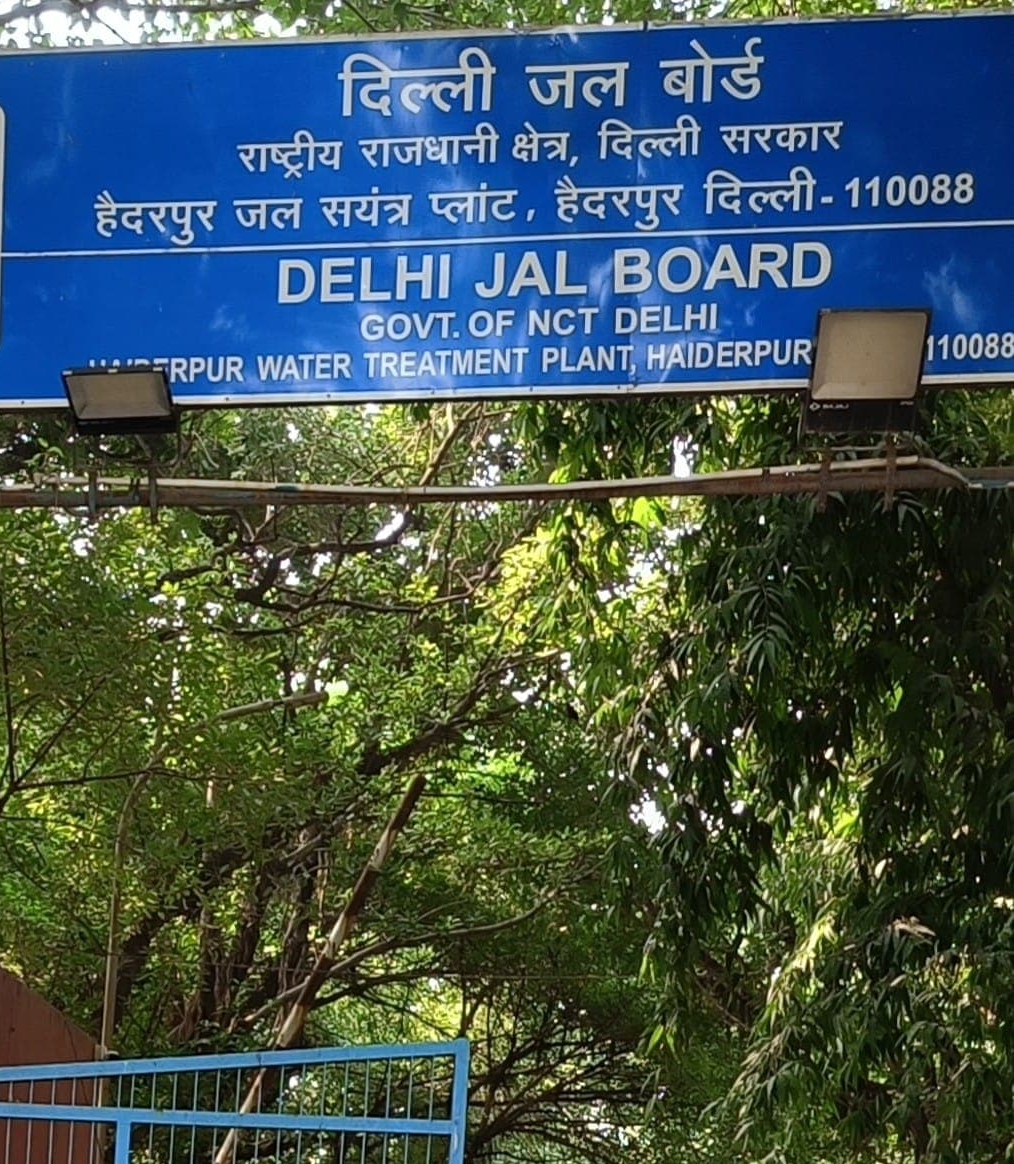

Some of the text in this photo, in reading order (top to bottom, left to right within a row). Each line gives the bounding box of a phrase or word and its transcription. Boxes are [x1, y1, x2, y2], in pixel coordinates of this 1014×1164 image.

[338, 37, 764, 116] दिल्ली जल बोर्ड
[238, 115, 843, 178] राष्ट्रीय राजधानी क्षेत्र, दिल्ली सरकार
[94, 191, 216, 245] हैदरपुर
[234, 198, 302, 230] जल
[555, 176, 683, 230] हैदरपुर
[845, 173, 974, 207] 110088
[279, 242, 832, 304] DELHI JAL BOARD
[361, 303, 718, 342] GOVT. OF NCT DELHI
[258, 354, 351, 382] WATER
[364, 348, 528, 378] TREATMENT
[542, 345, 636, 374] PLANT,
[647, 340, 812, 370] HAIDERPUR
